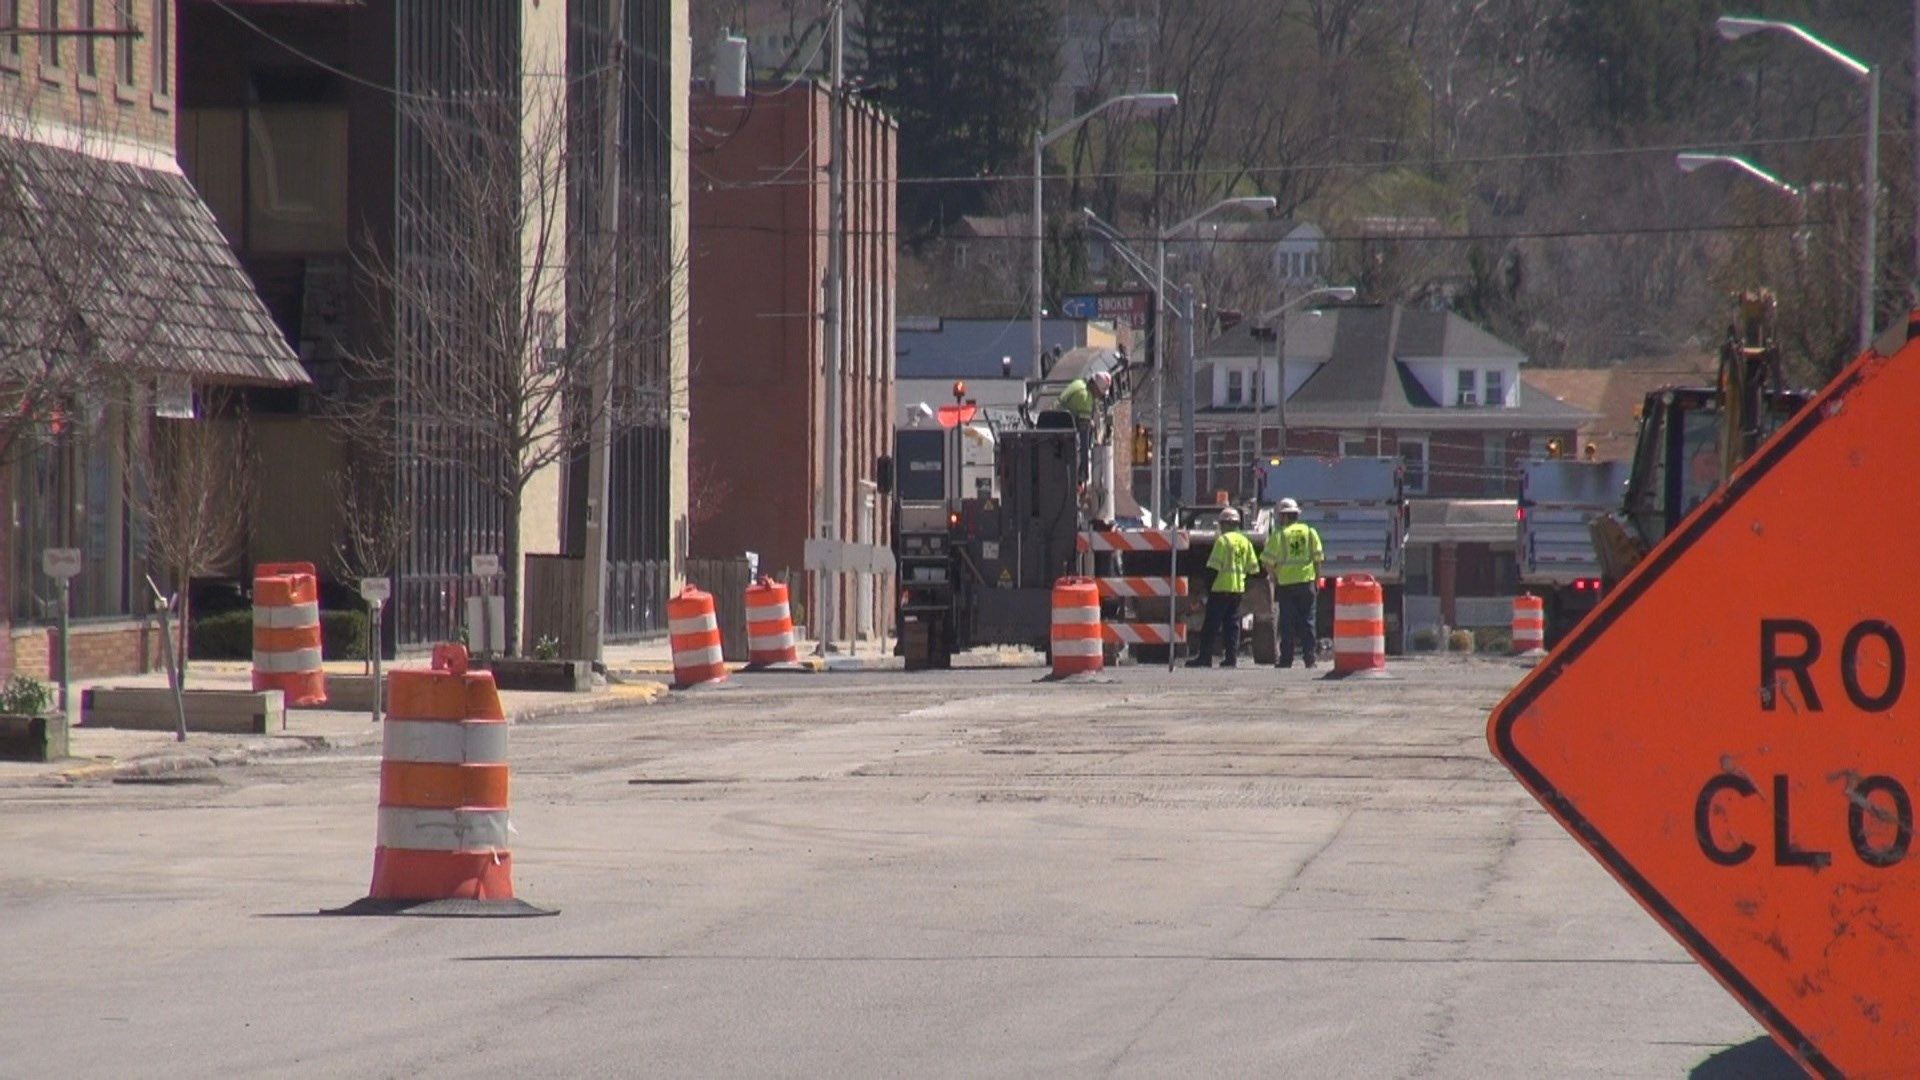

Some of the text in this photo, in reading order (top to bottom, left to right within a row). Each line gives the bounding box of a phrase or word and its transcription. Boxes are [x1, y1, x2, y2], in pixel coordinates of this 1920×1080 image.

[1097, 297, 1134, 311] SMOKER
[1760, 618, 1907, 713] RO
[1694, 773, 1914, 869] CLO
